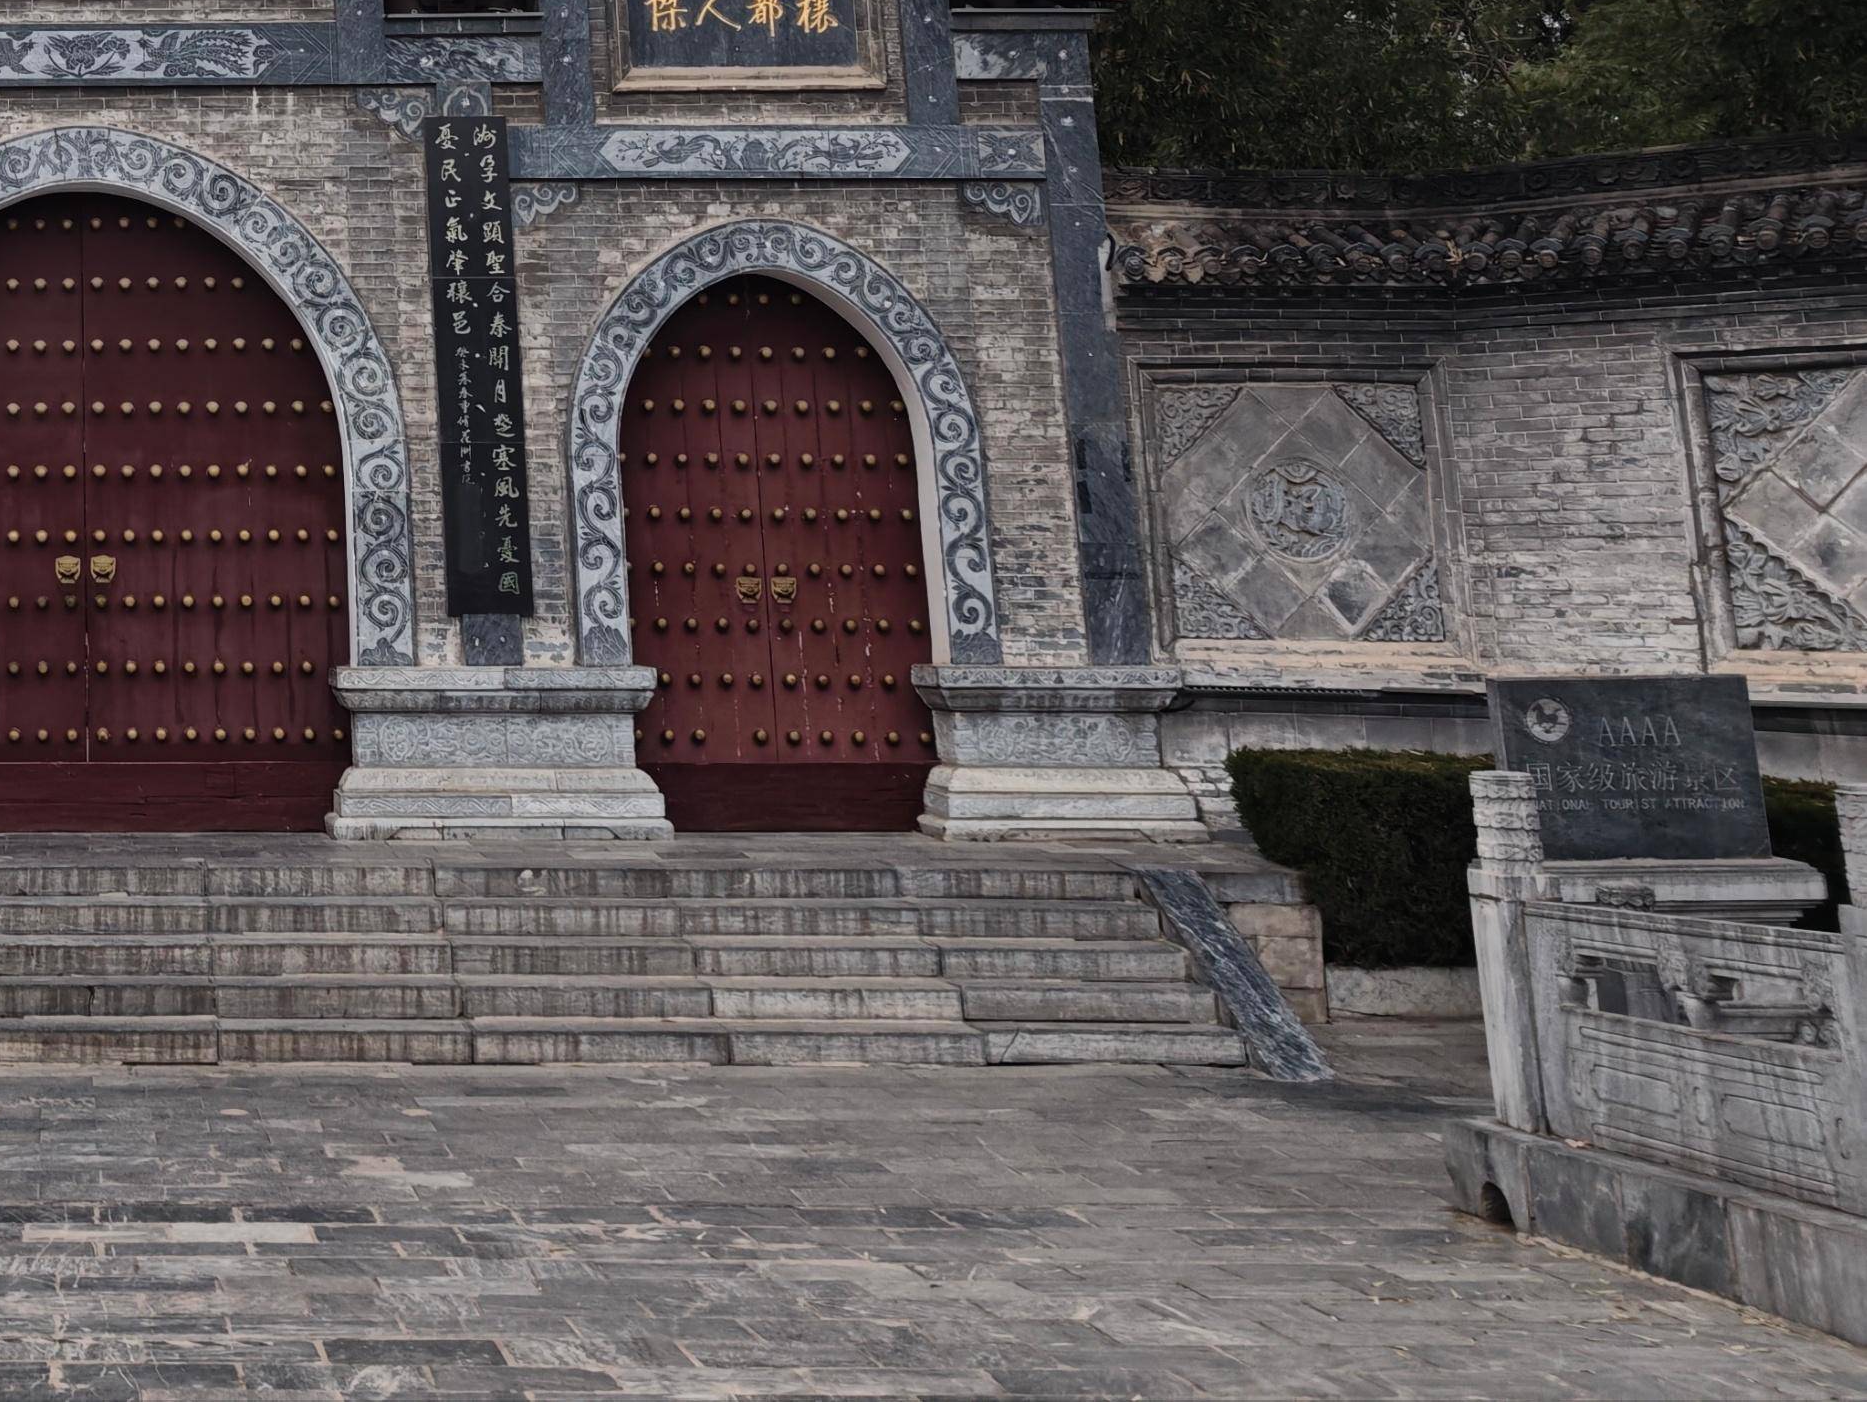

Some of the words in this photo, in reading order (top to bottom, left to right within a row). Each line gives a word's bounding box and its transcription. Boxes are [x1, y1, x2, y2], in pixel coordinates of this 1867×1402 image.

[1599, 716, 1682, 747] AAAA
[1527, 761, 1742, 793] 国家级旅游景区
[1601, 798, 1656, 811] TOURIST
